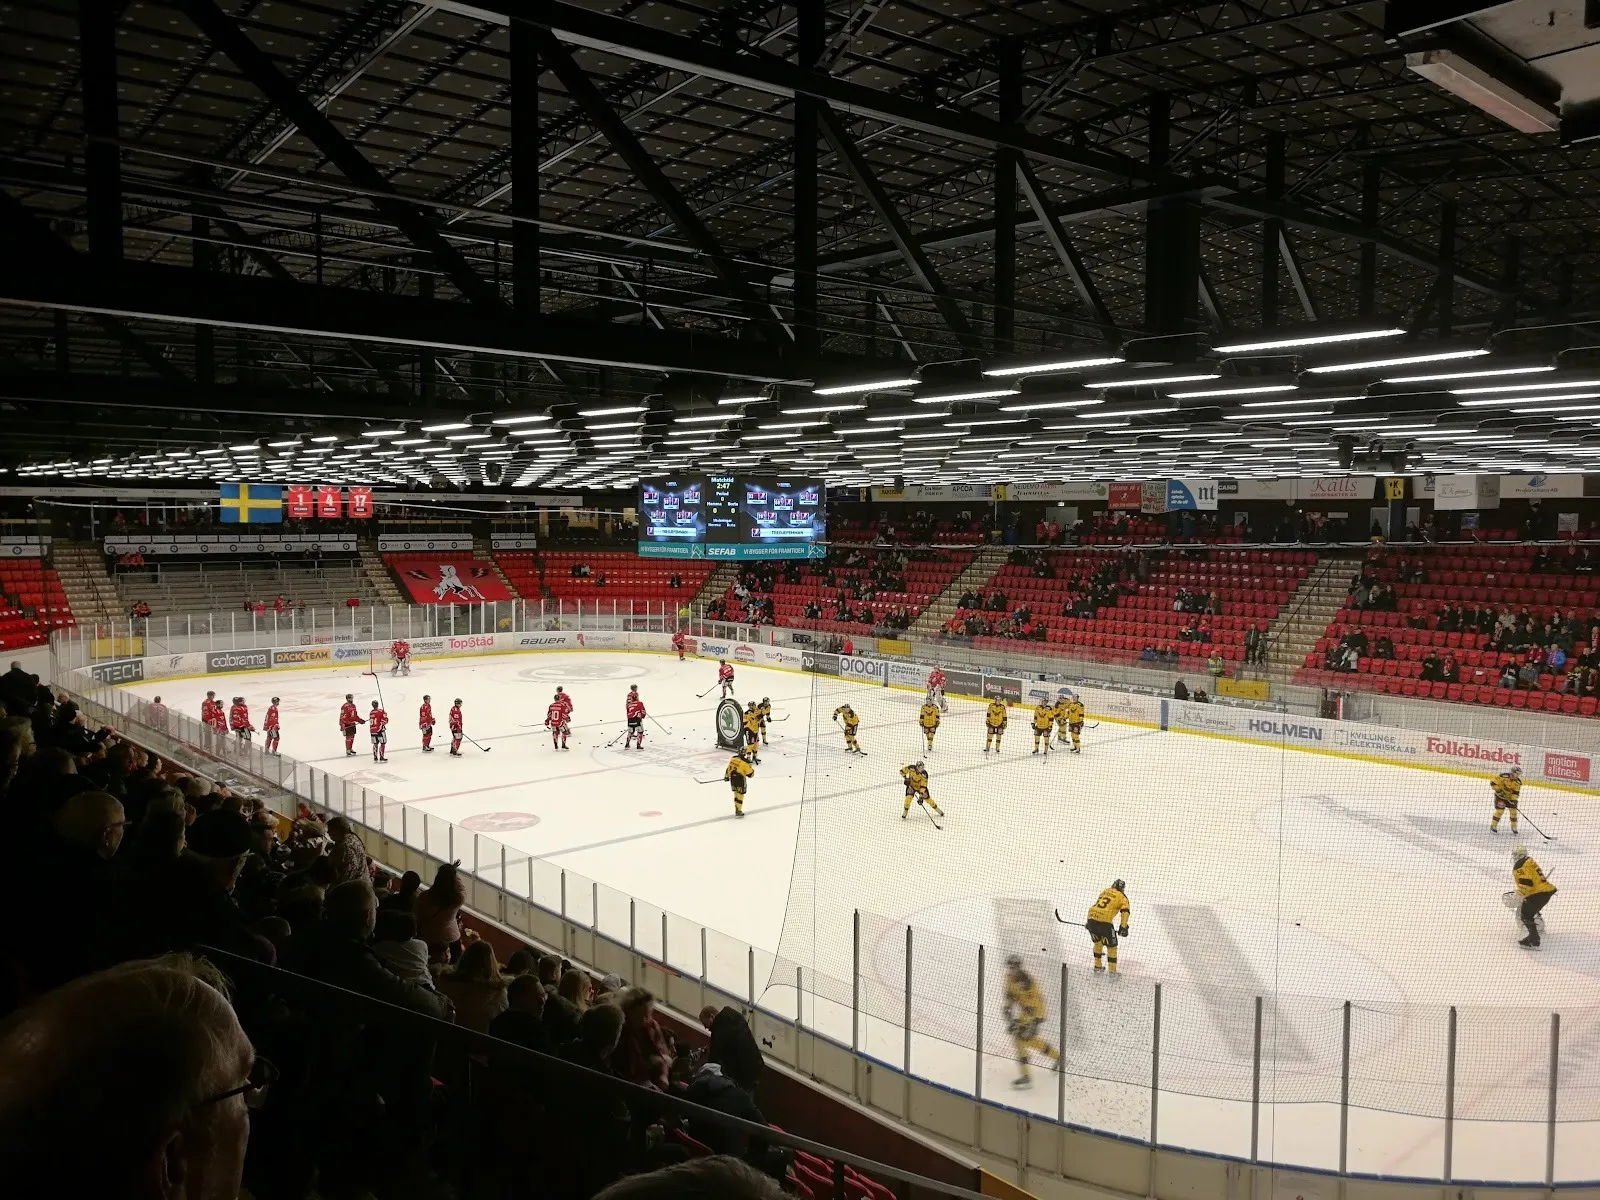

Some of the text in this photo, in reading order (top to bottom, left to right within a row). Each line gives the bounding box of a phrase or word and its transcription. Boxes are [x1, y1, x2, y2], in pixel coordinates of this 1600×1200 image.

[1310, 478, 1358, 492] Källs
[1393, 480, 1398, 488] K
[1198, 485, 1216, 500] nt
[297, 494, 303, 506] 1
[326, 494, 333, 507] 4
[354, 494, 367, 507] 17
[448, 636, 494, 649] TopStäd
[521, 637, 566, 645] BAUER
[702, 643, 728, 655] Swegon
[212, 653, 267, 668] colorama
[276, 651, 328, 662] DÄCK TEAM
[840, 657, 884, 676] proair
[551, 711, 559, 720] 10
[1205, 719, 1228, 727] project
[1249, 719, 1322, 740] HOLMEN
[1350, 731, 1395, 743] KVILLINGE
[1350, 739, 1416, 754] ELEKTRISKA AB
[1426, 736, 1521, 765] Folkbladet
[1548, 756, 1577, 768] motion
[1547, 766, 1581, 779] &fitness
